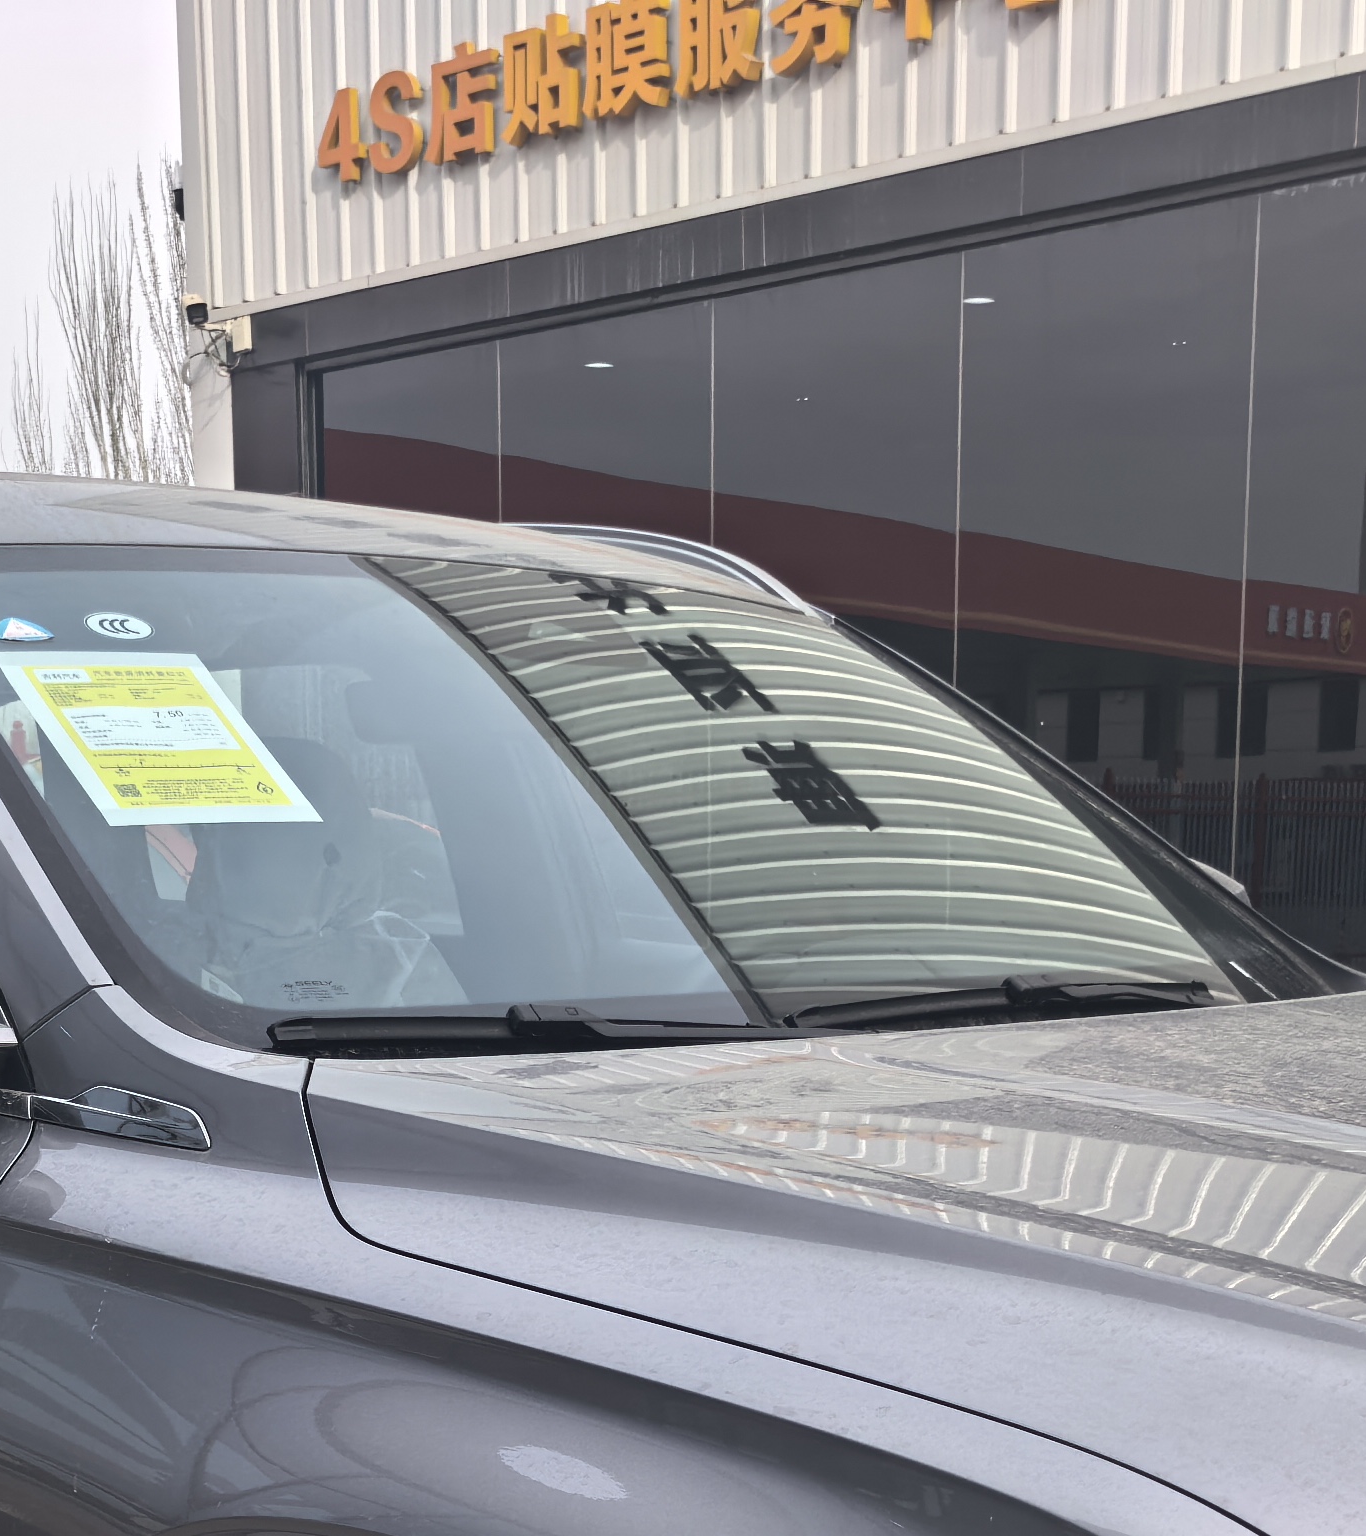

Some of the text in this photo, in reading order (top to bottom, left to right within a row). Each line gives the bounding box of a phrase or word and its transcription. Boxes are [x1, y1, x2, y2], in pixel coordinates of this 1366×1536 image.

[317, 0, 1060, 183] 4S店贴膜服务
[152, 709, 184, 719] 7.50
